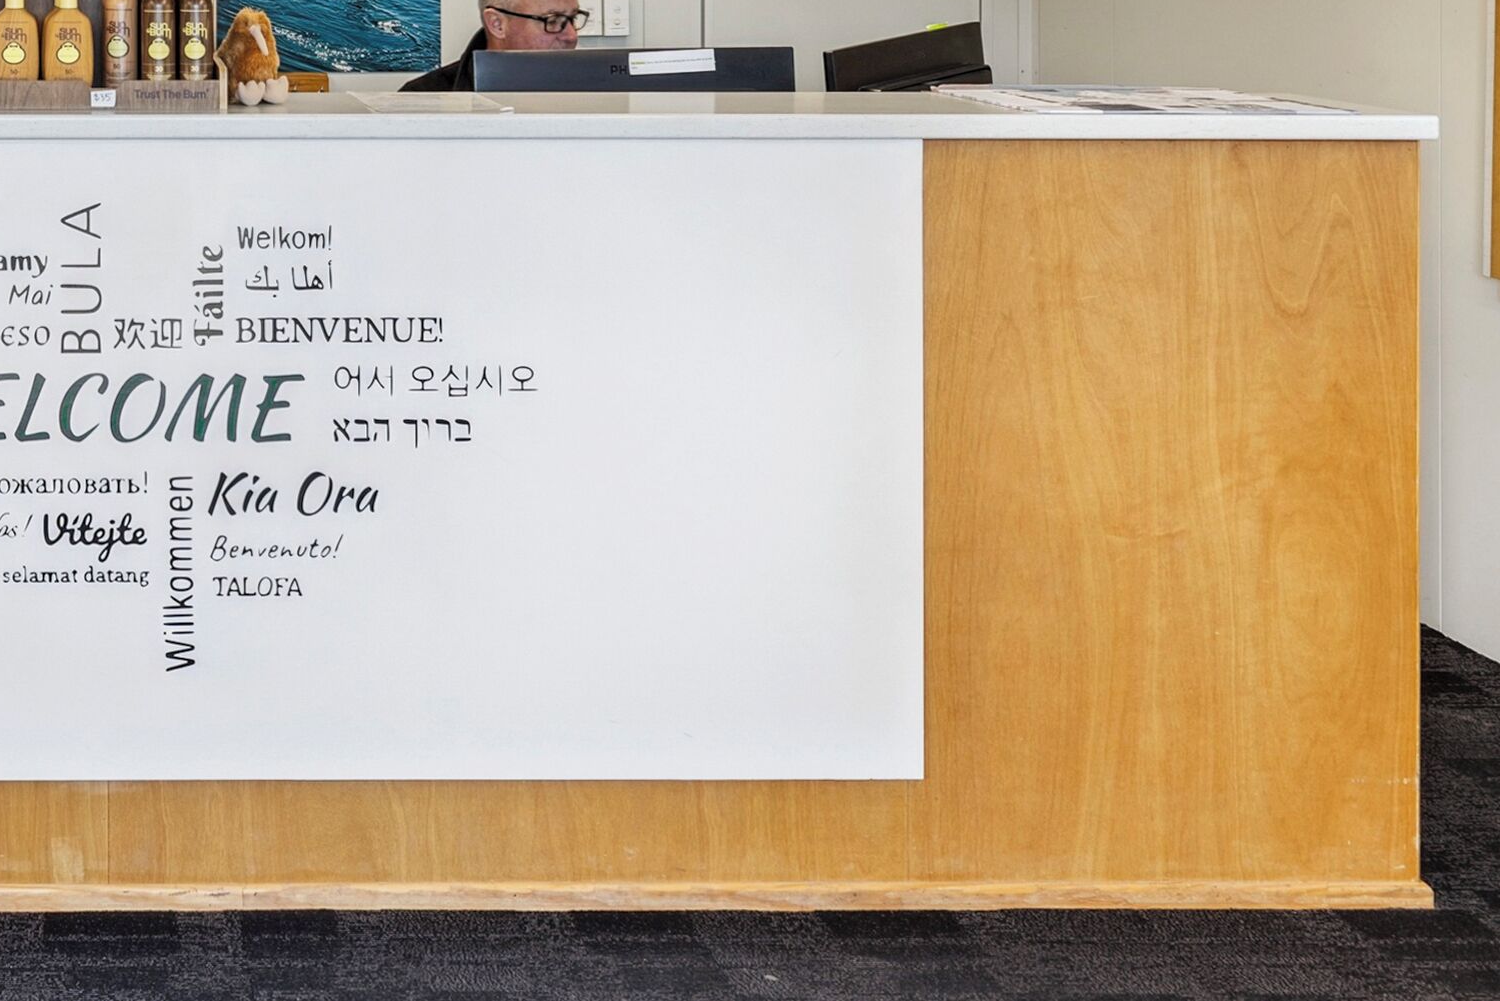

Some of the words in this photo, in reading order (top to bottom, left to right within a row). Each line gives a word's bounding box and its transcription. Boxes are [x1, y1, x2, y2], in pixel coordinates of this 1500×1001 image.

[133, 89, 161, 99] Trust
[162, 89, 181, 99] The
[237, 225, 333, 250] Welkom!
[60, 202, 102, 354] BULA
[8, 283, 54, 306] Mai
[113, 317, 183, 350] 欢迎
[235, 316, 444, 344] BIENVENUE!
[334, 365, 394, 397] 어서
[408, 364, 539, 398] 오십시오
[332, 417, 391, 443] הבא
[207, 471, 279, 517] Kia
[296, 470, 380, 517] Ora
[209, 533, 344, 562] Benvenuto!
[2, 565, 78, 585] selamat
[83, 565, 150, 588] datang
[162, 475, 196, 673] Willkommen
[212, 575, 303, 598] TALOFA
